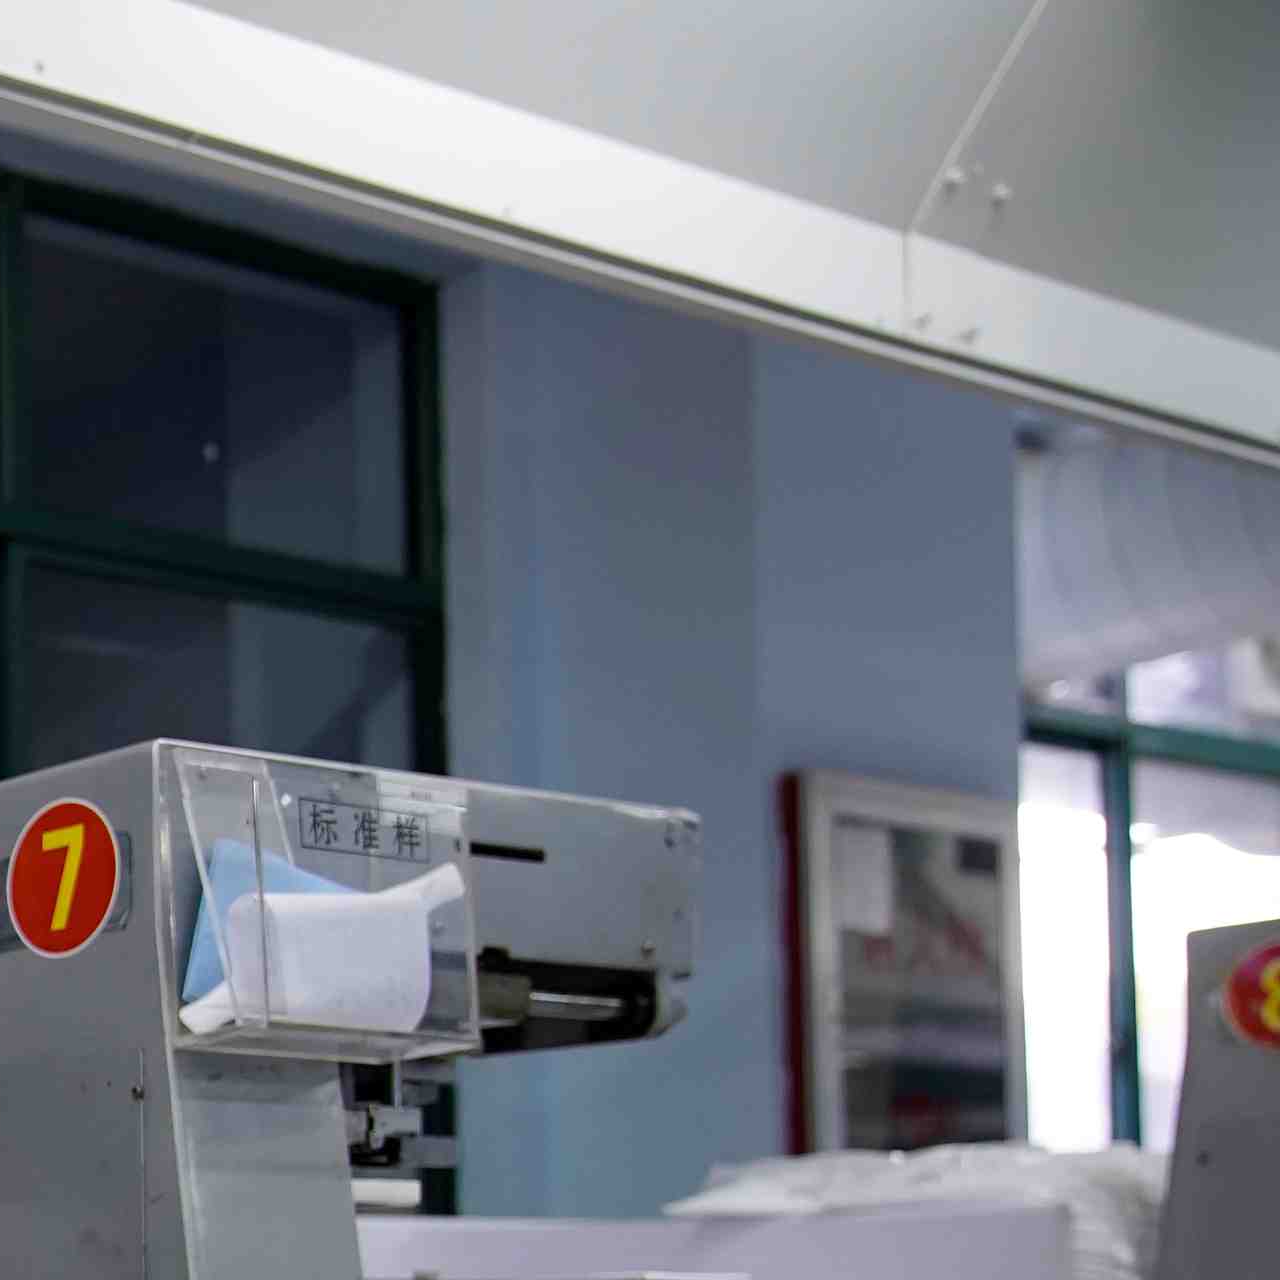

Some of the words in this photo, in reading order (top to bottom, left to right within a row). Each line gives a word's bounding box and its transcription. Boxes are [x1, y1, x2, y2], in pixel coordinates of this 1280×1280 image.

[309, 804, 422, 858] 标准样
[41, 822, 86, 932] 7
